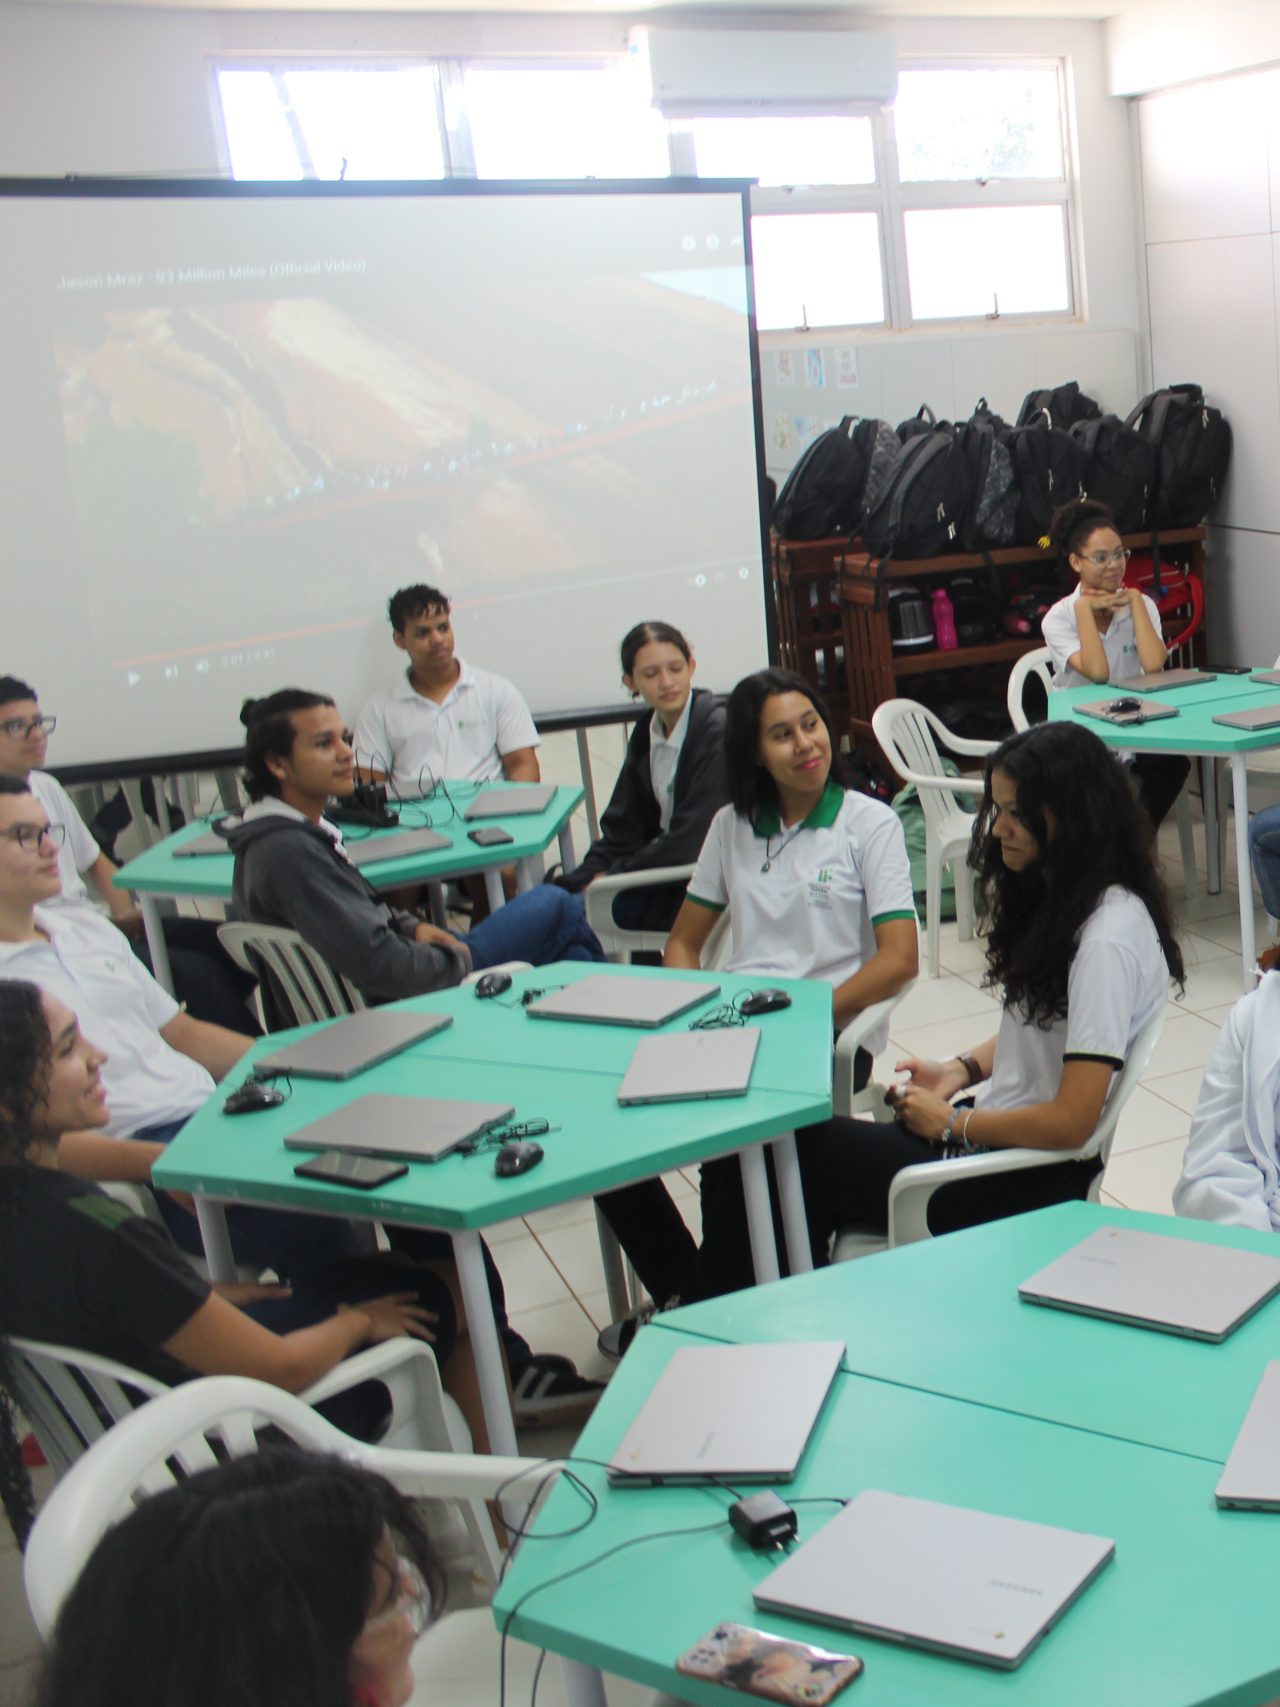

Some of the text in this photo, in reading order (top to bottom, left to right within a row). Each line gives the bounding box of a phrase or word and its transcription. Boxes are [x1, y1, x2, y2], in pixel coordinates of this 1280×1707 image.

[56, 273, 104, 291] Jason
[178, 265, 225, 284] Million
[228, 262, 267, 281] Miles
[324, 256, 368, 275] Video)
